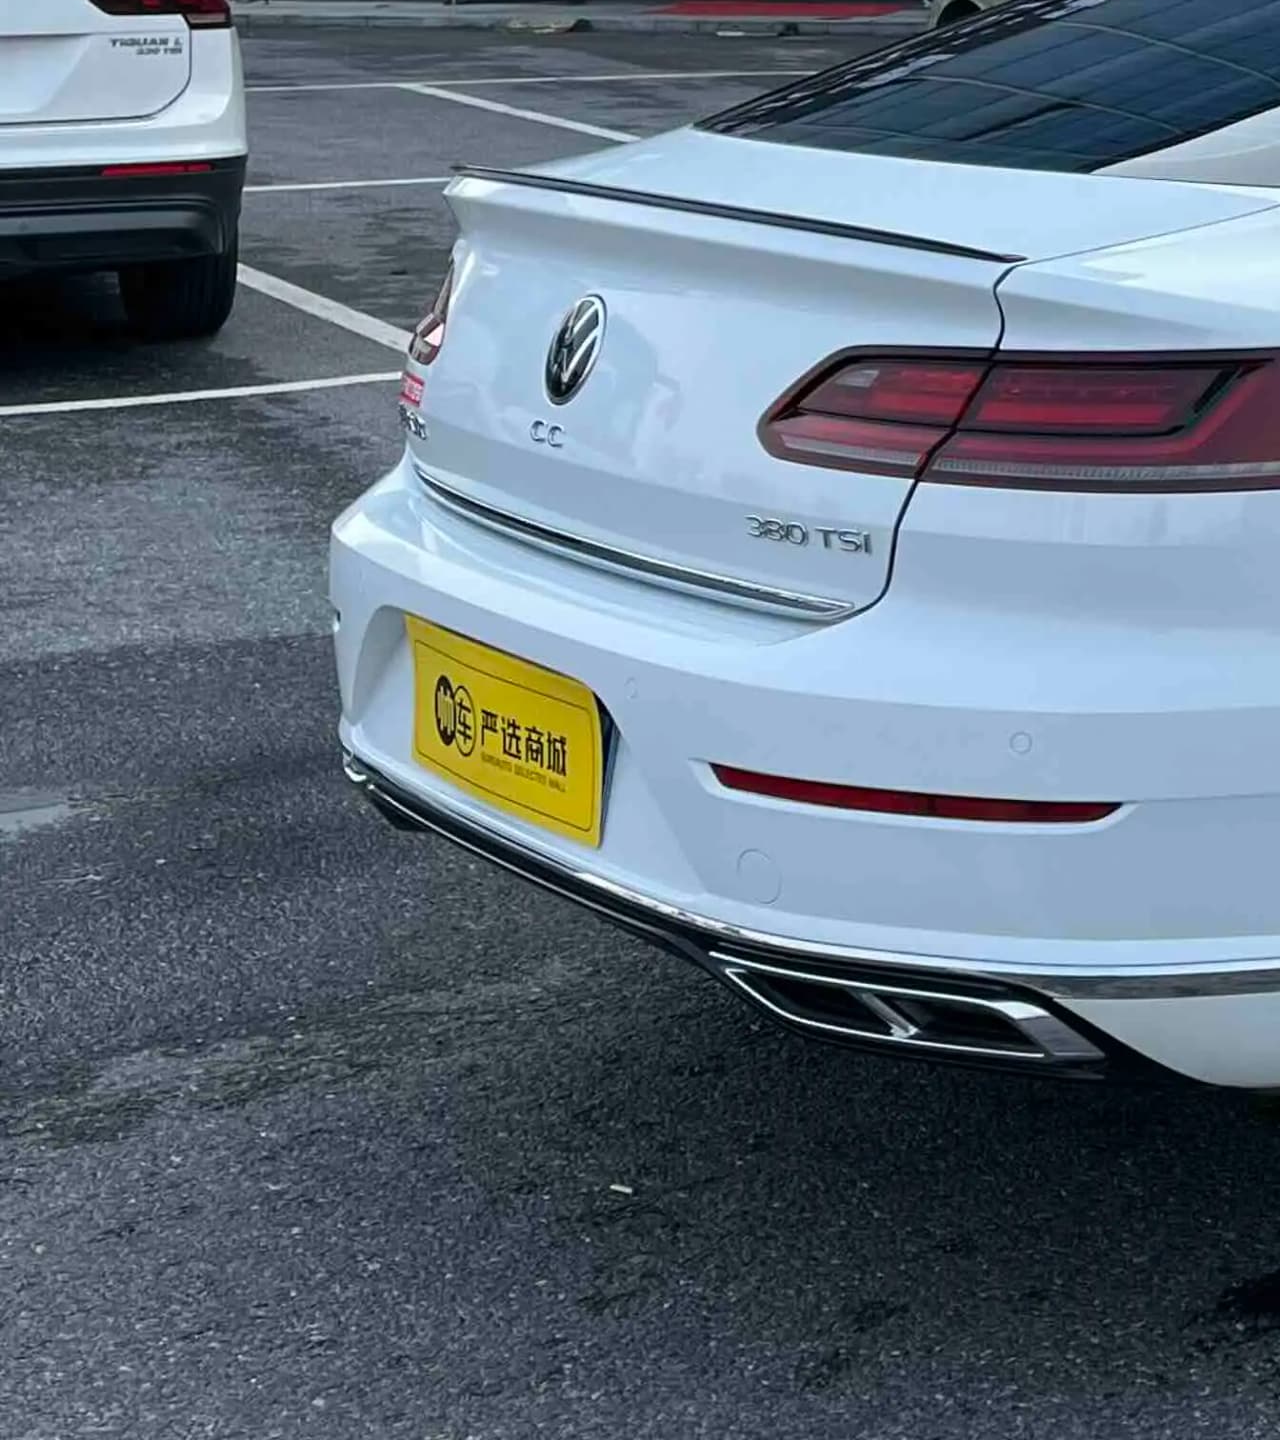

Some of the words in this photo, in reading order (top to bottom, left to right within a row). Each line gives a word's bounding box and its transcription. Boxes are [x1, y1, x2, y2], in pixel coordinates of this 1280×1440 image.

[529, 419, 565, 449] CC
[745, 514, 810, 547] 380
[814, 525, 873, 556] TSI
[480, 708, 568, 778] 严选商城
